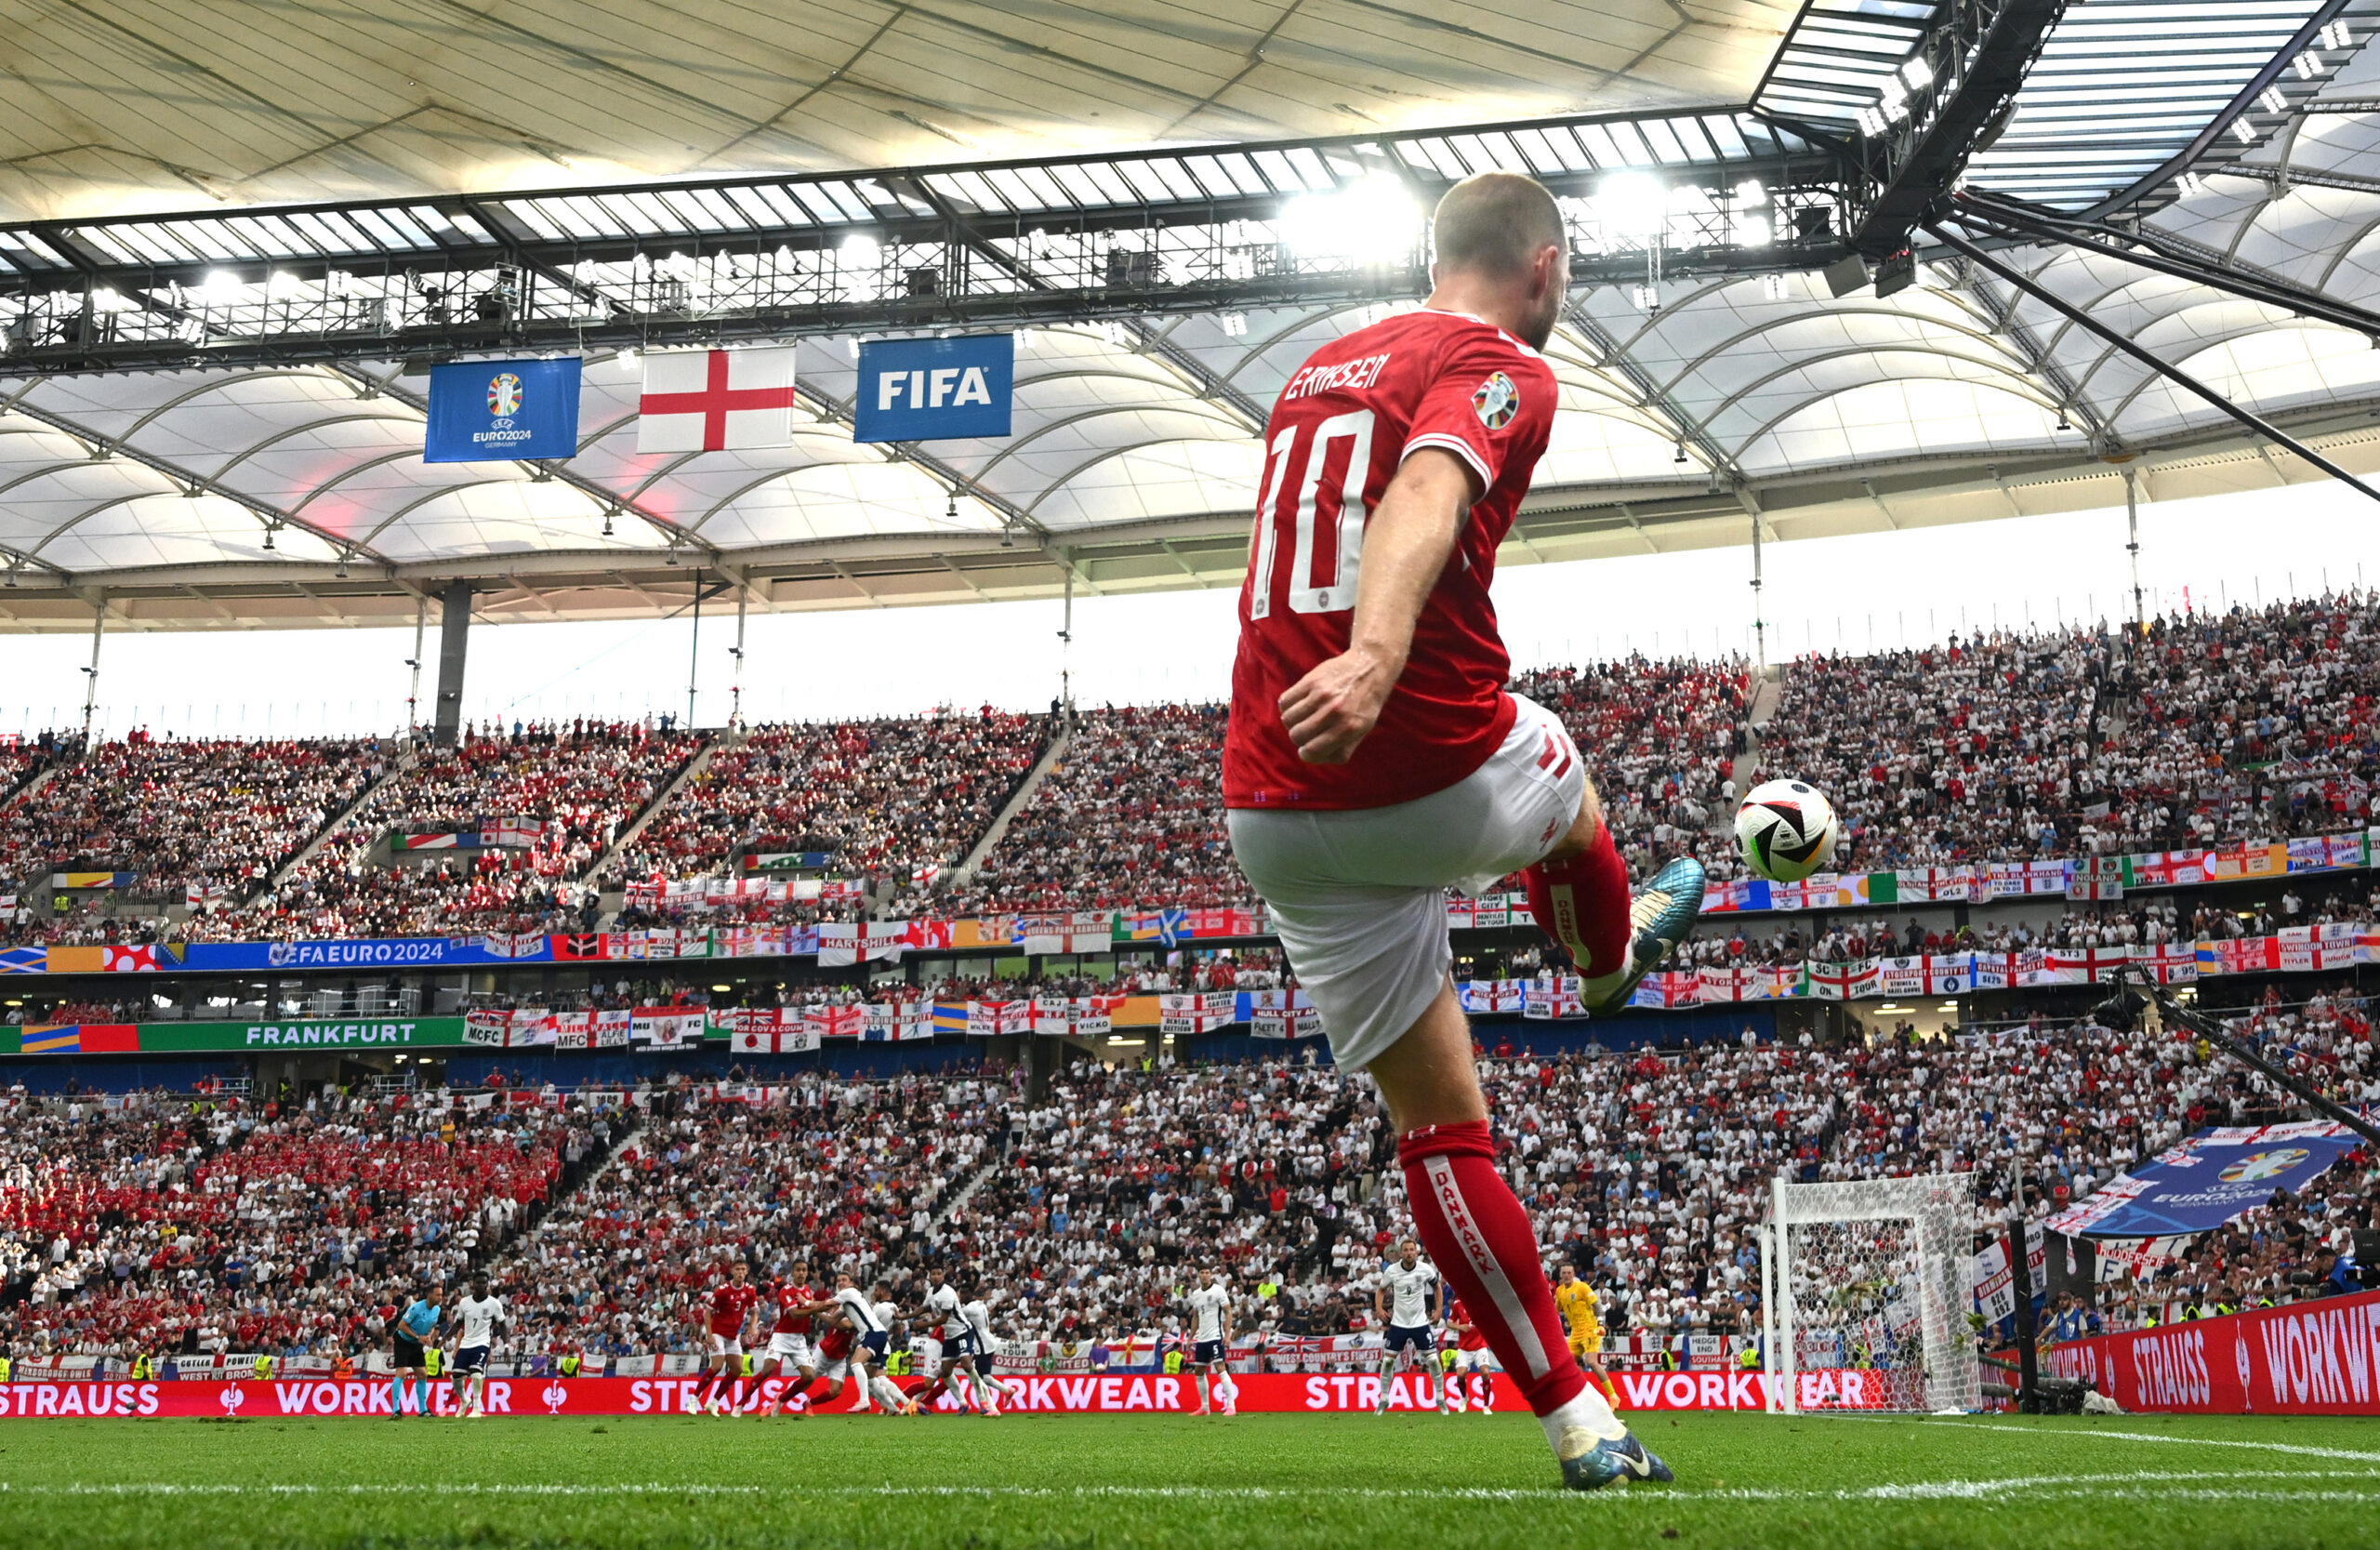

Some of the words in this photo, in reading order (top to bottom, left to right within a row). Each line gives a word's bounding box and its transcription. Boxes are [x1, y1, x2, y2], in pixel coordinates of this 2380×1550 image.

[1284, 353, 1391, 401] ERIKSEN
[878, 366, 993, 411] FIFA
[491, 418, 515, 431] UEFA
[472, 430, 532, 443] EURO2024
[1251, 409, 1376, 621] 10
[2071, 874, 2116, 882] ENGLAND
[826, 936, 897, 948] HARTSHILL
[2324, 939, 2351, 949] TOWN
[271, 943, 443, 964] EFAEURO2024
[1282, 1009, 1302, 1017] CITY
[561, 1022, 621, 1033] MILLWALL
[751, 1024, 769, 1032] COV
[779, 1024, 804, 1032] COUN
[246, 1024, 416, 1045] FRANKFURT
[468, 1027, 499, 1043] MCFC
[558, 1034, 586, 1047] MFC
[1435, 1171, 1494, 1275] DANMARK
[2100, 1248, 2177, 1267] HUDDERSFIE
[1407, 1286, 1412, 1295] 9
[735, 1301, 741, 1311] 3
[472, 1318, 478, 1329] 7
[958, 1340, 968, 1349] 10
[1426, 1332, 1433, 1345] 9
[479, 1352, 485, 1362] 7
[1053, 1358, 1090, 1369] NITED
[1277, 1354, 1301, 1365] WEST
[1302, 1352, 1349, 1363] COUNTRY'S
[1352, 1350, 1380, 1361] FINEST
[1600, 1353, 1655, 1364] BRNLEY
[70, 1369, 91, 1378] OWLS
[2134, 1328, 2210, 1406] STRAUSS
[179, 1372, 210, 1381] WEST
[274, 1382, 512, 1413] WORKWER
[1305, 1375, 1496, 1409] STRAUSS
